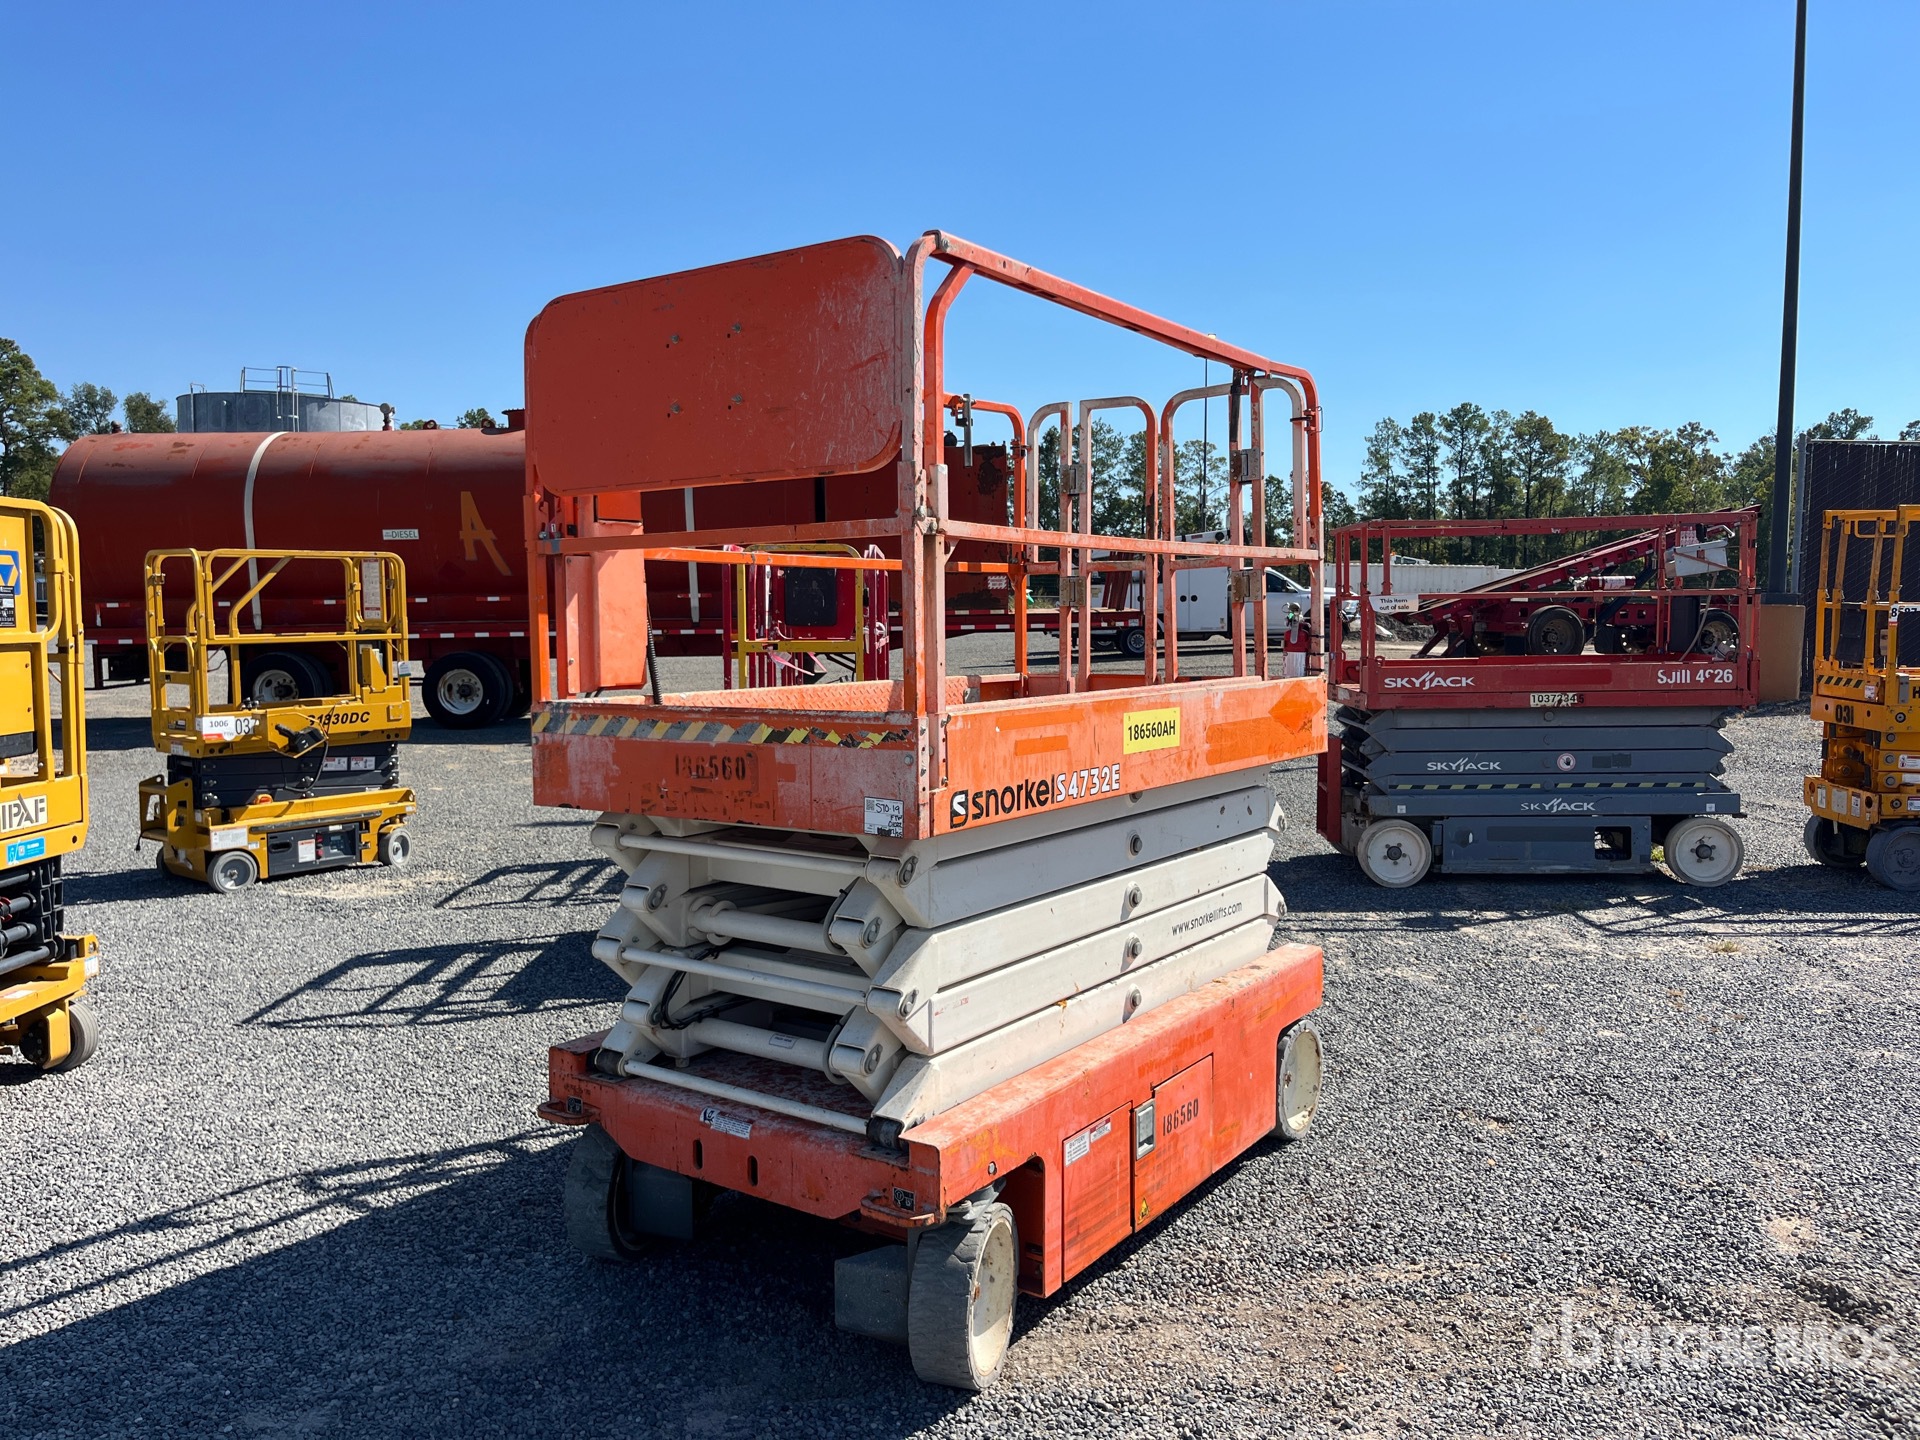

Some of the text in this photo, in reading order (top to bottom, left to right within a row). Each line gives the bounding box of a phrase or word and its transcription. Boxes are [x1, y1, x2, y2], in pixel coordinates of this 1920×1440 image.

[391, 530, 418, 539] DIESEL
[460, 491, 513, 576] A
[1384, 671, 1476, 690] SKYJACK
[209, 719, 229, 728] 1006
[1128, 719, 1176, 741] 186560AH
[1426, 757, 1502, 772] SKYJACK
[971, 762, 1121, 820] snorkel S4732E
[1, 793, 46, 830] IPAF
[1520, 798, 1596, 812] SKYJACK
[1172, 902, 1243, 936] www.snorkellifts.com
[1162, 1098, 1199, 1137] 186560
